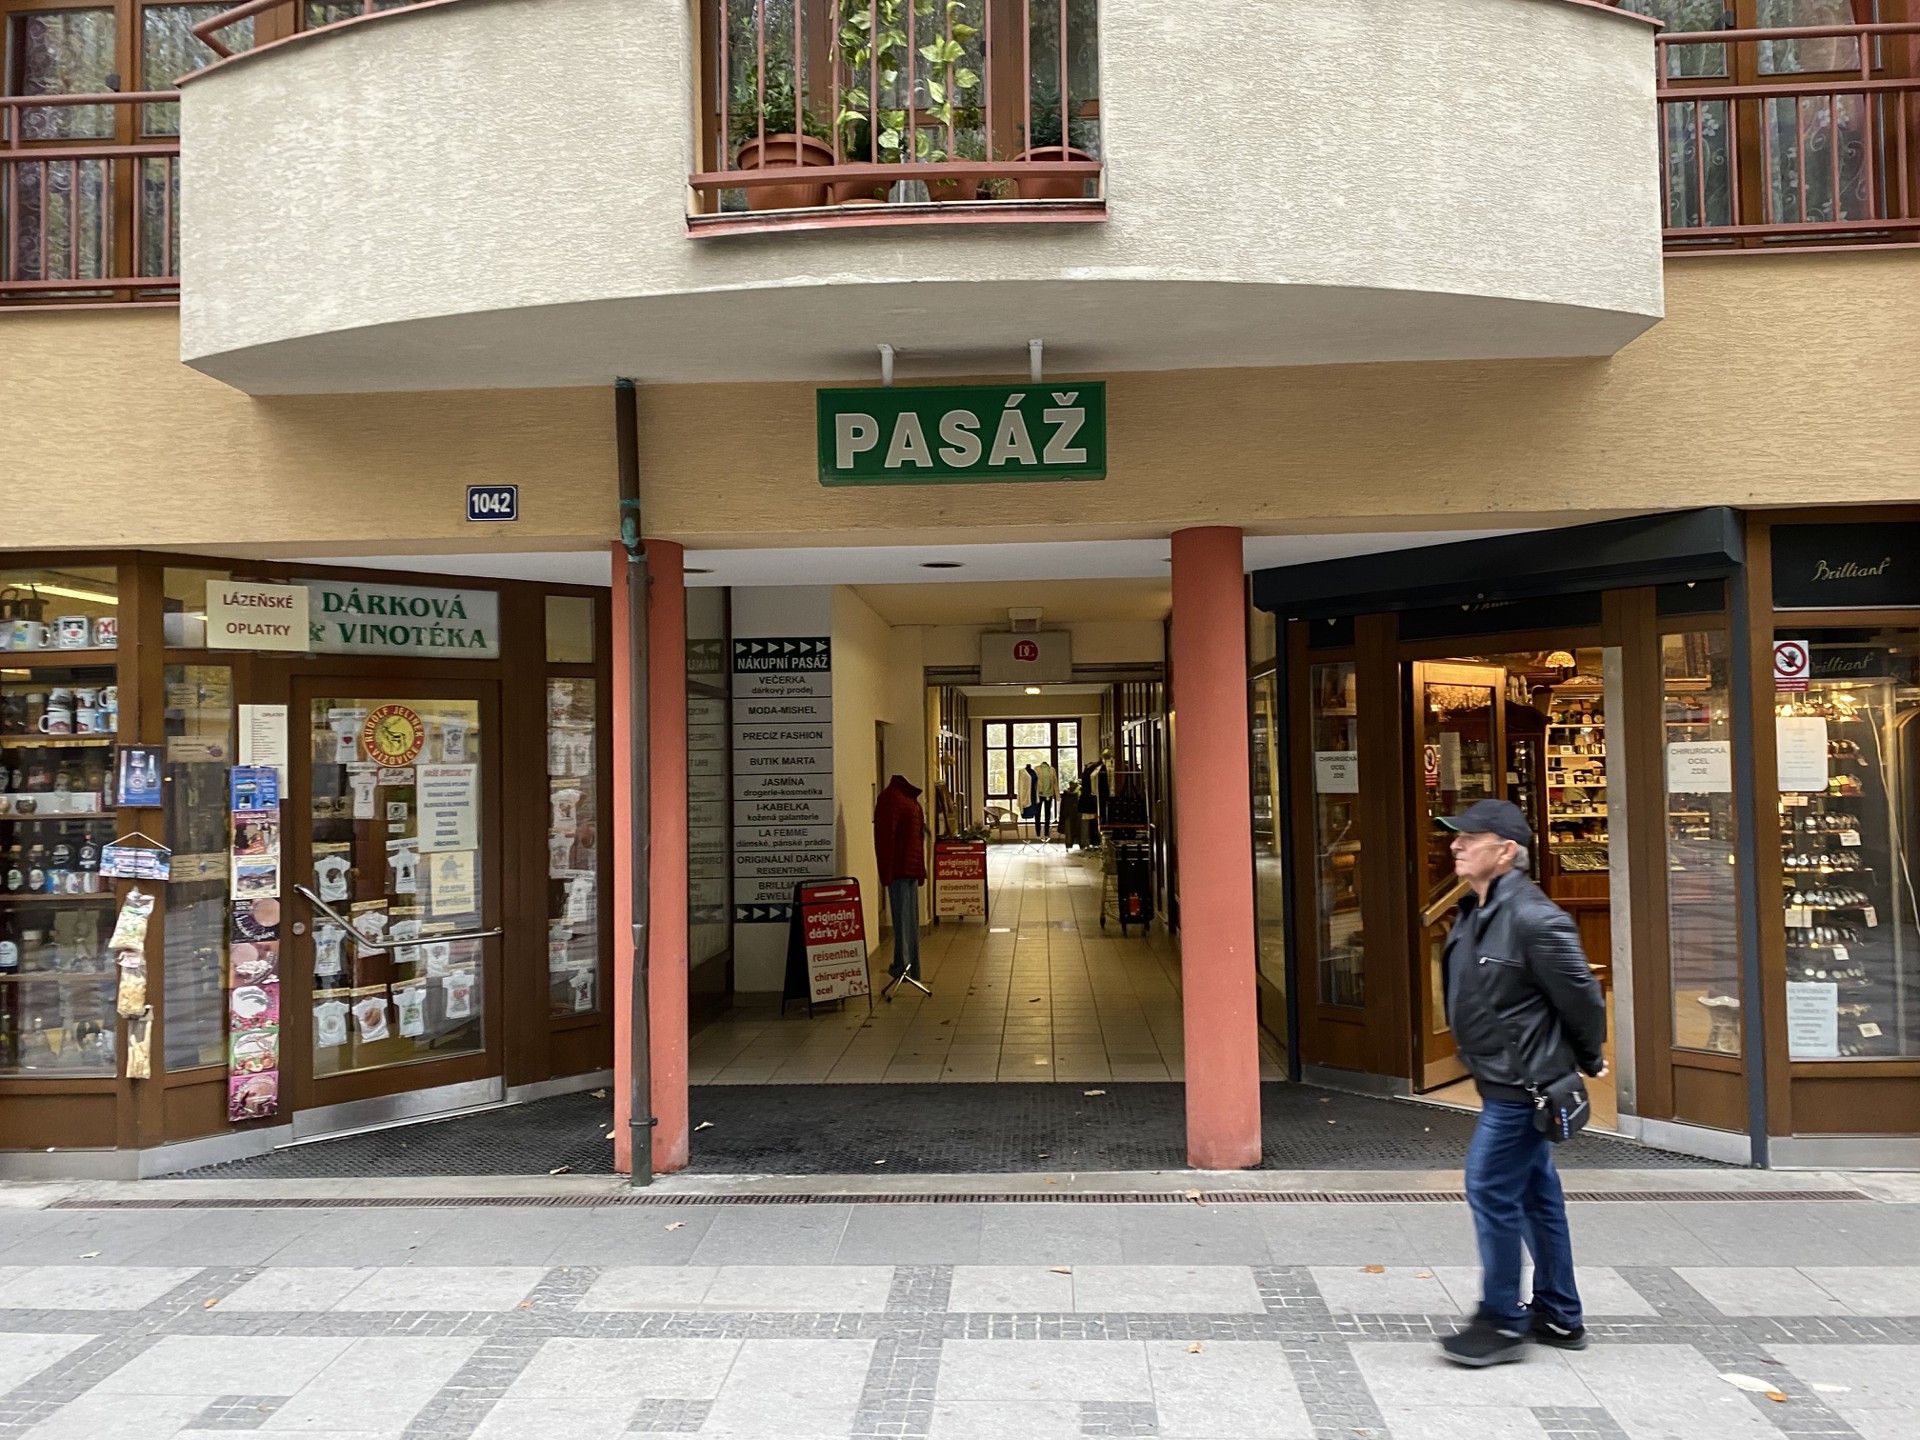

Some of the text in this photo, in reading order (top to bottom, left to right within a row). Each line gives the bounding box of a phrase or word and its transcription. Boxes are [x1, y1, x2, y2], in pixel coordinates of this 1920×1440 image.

[835, 392, 1087, 469] PASÁŽ
[471, 492, 511, 514] 1042
[1811, 557, 1891, 582] Brilliant
[223, 592, 293, 609] LÁZEŇSKÉ
[322, 588, 468, 620] DÁRKOVÁ
[226, 622, 291, 636] OPLATKY
[337, 621, 487, 649] VINOTÉKA
[737, 654, 828, 670] NÁKUPNÍ PASÁŽ
[759, 676, 806, 685] VEČERKA
[787, 687, 813, 695] prodej
[748, 707, 817, 715] MODA-MISHEL
[364, 706, 423, 743] RUDOLF JELINEK
[743, 731, 823, 741] PRECIZ FASHION
[371, 746, 421, 765] VIZOVICE
[750, 757, 816, 766] BUTIK MARTA
[762, 777, 805, 787] JASMÍNA
[757, 803, 810, 812] I-KABELKA
[747, 813, 819, 822] kožená galanterie
[758, 829, 808, 838] LA FEMME
[737, 854, 794, 864] ORIGINÁLNÍ
[938, 858, 979, 868] originální
[757, 867, 811, 875] REISENTHEL
[938, 868, 964, 877] dárky
[940, 897, 980, 905] chirurgická
[807, 909, 856, 924] originální
[808, 929, 838, 940] dárky
[813, 949, 859, 963] reisenthel
[814, 969, 861, 982] chirurgická
[816, 986, 833, 995] ocel
